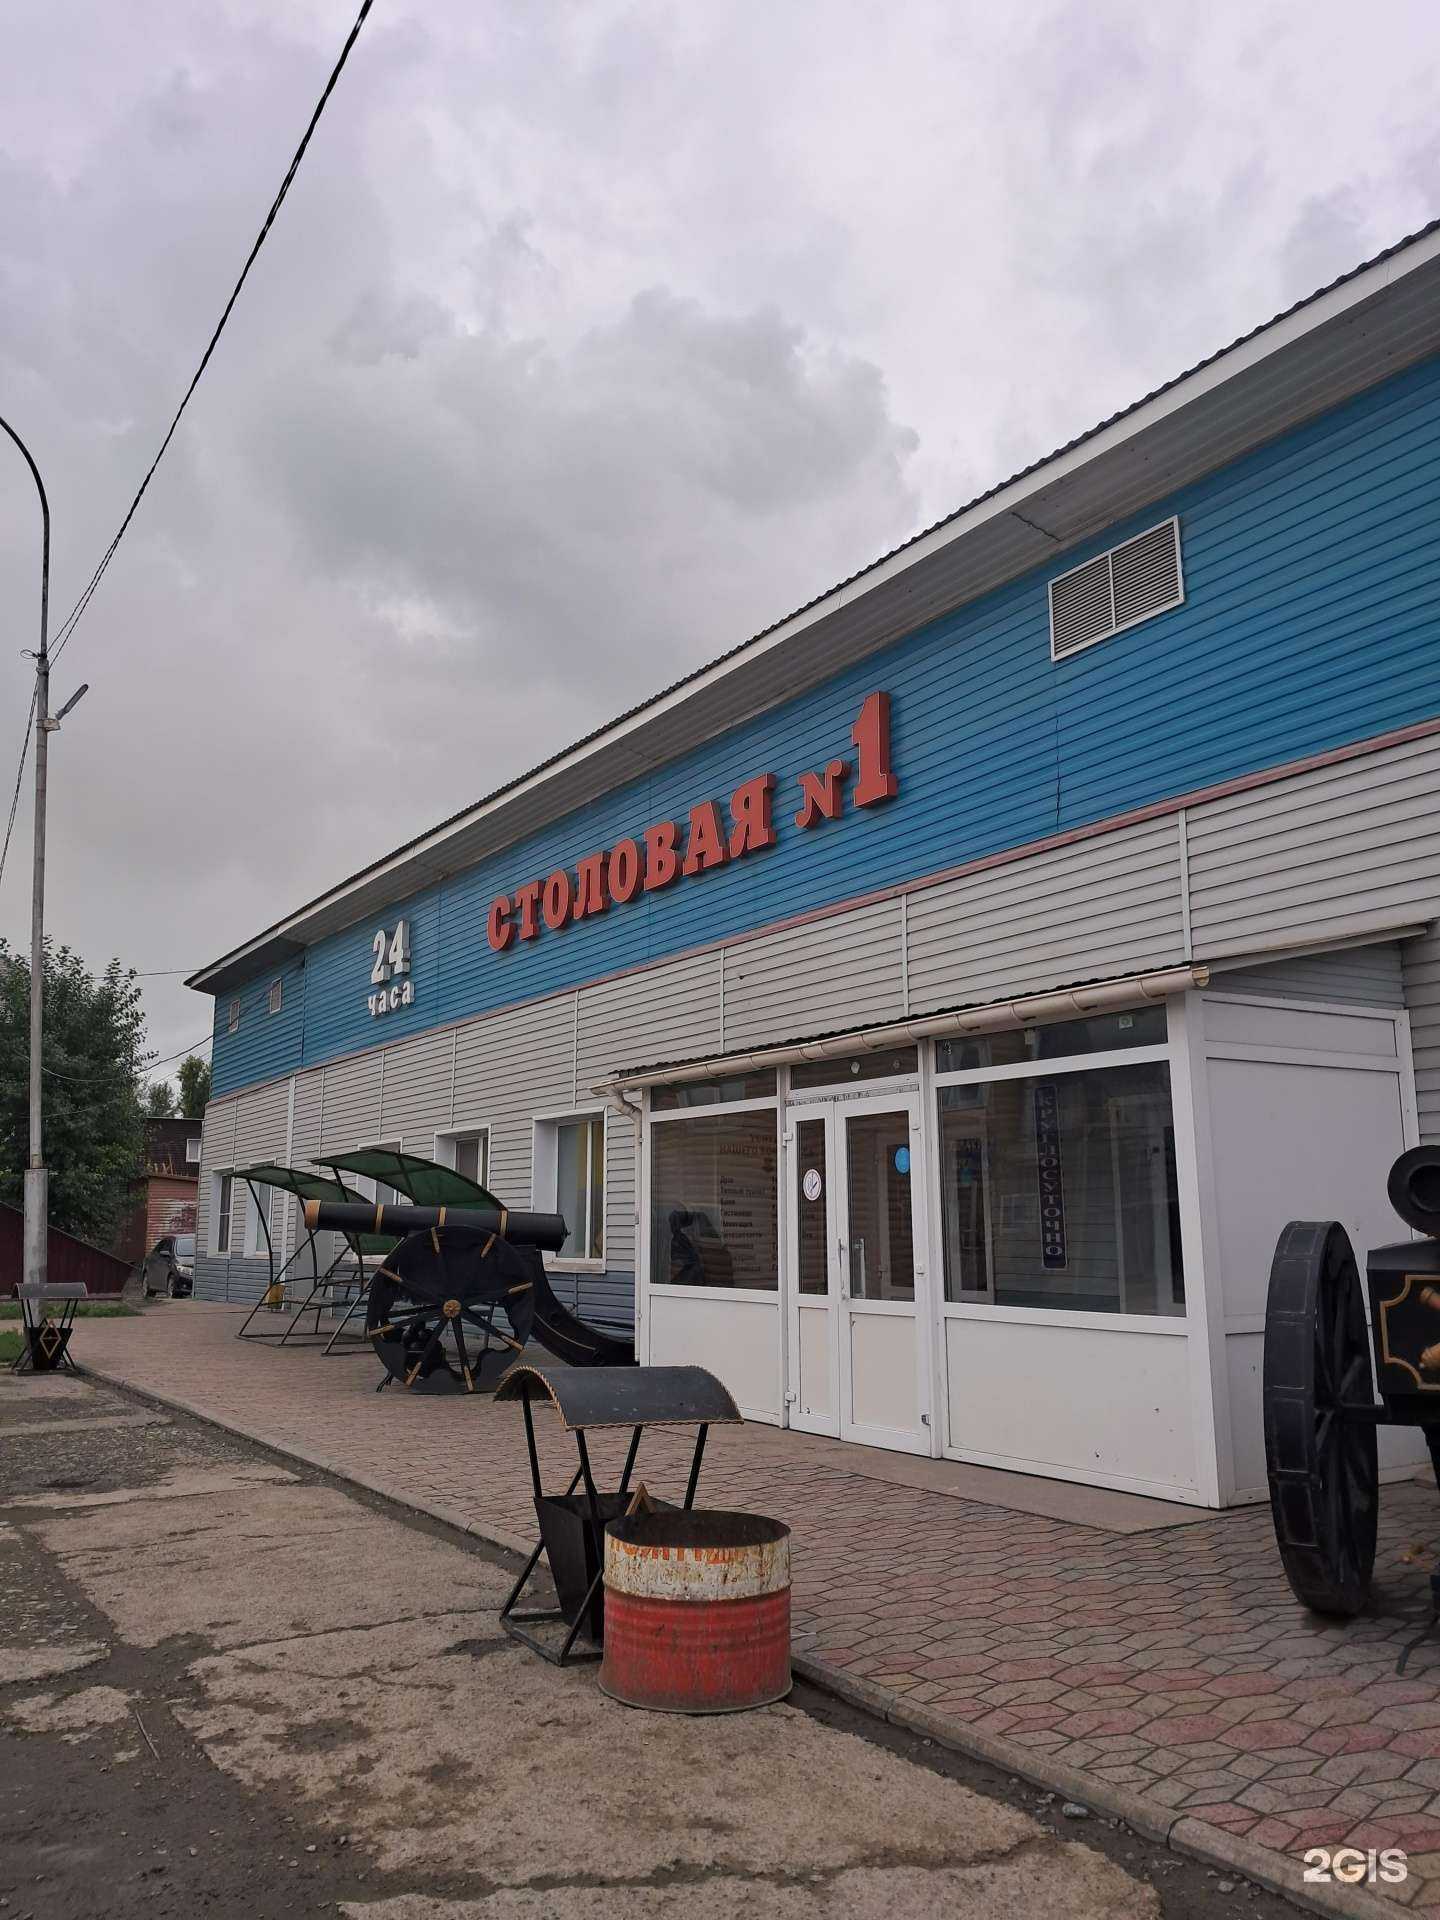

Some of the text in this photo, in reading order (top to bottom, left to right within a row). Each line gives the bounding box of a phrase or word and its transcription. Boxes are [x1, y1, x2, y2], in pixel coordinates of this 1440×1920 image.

[486, 772, 777, 952] СТОЛОВАЯ
[370, 920, 411, 985] 24
[367, 980, 416, 1017] часа
